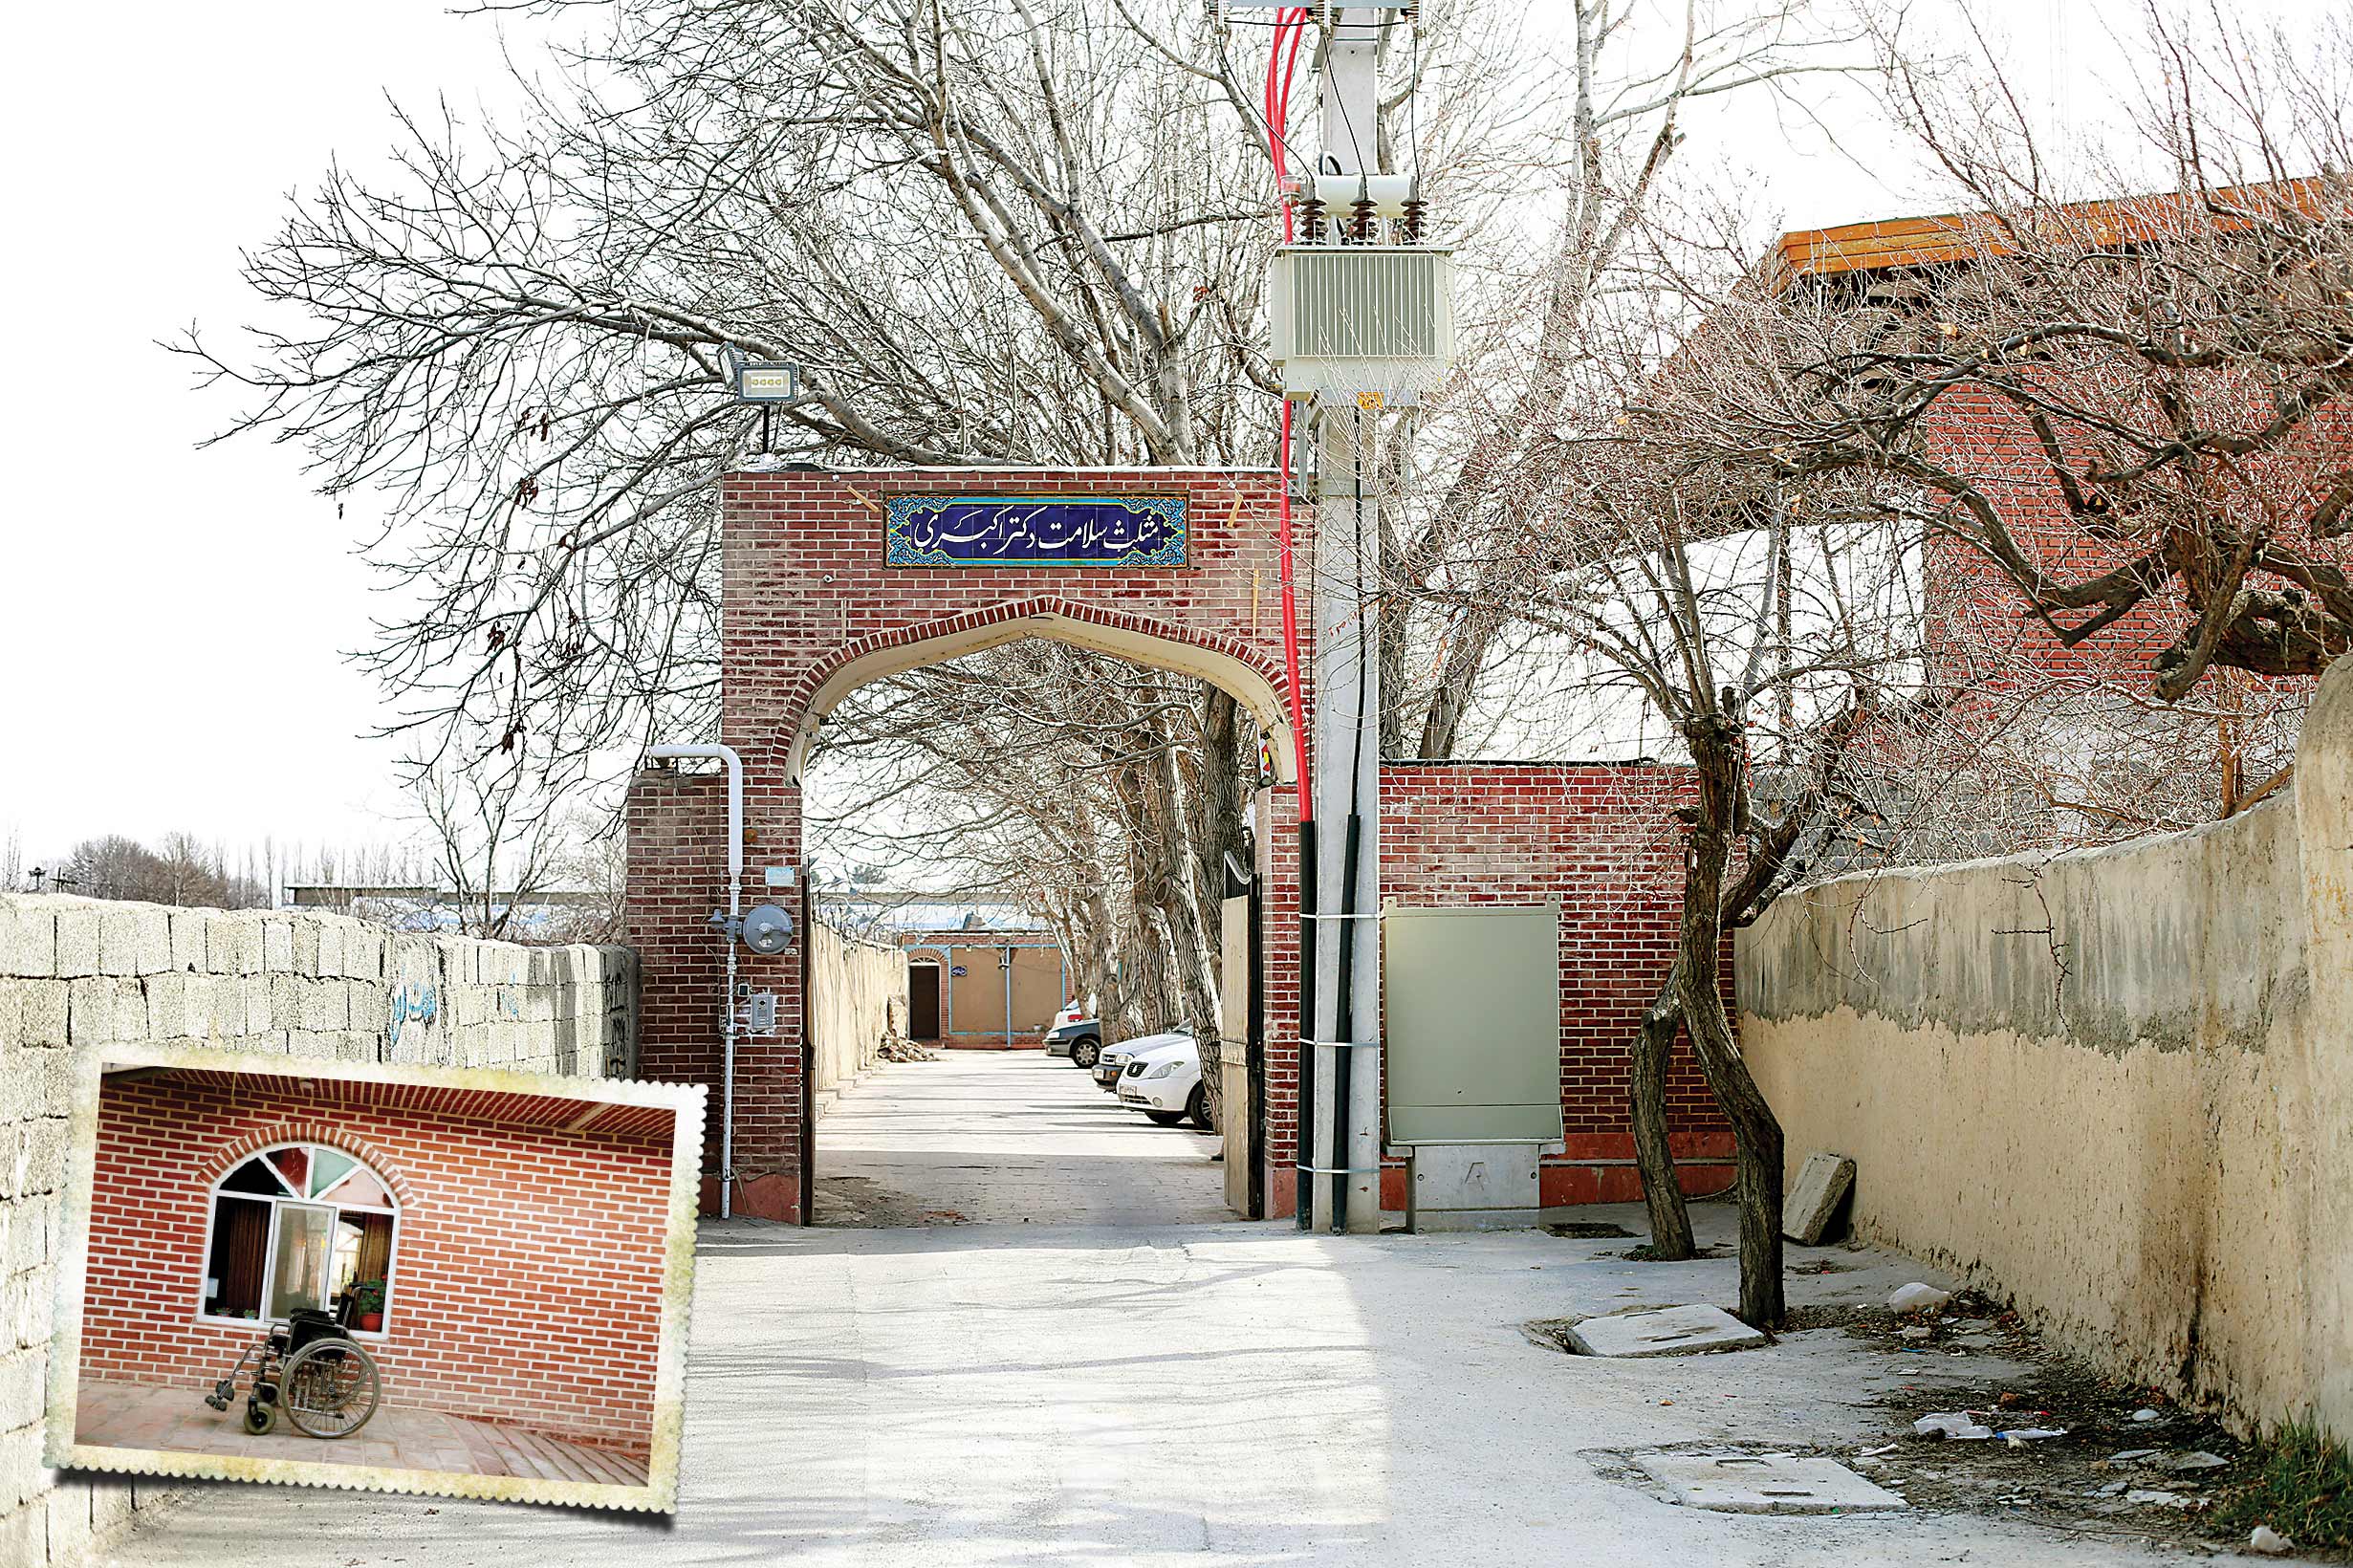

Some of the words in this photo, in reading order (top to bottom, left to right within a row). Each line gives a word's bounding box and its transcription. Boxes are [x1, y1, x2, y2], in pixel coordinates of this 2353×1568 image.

[914, 505, 1013, 550] اکبری
[993, 506, 1048, 555] دکتر
[1038, 518, 1107, 549] سلامت
[1103, 515, 1158, 550] مثلث
